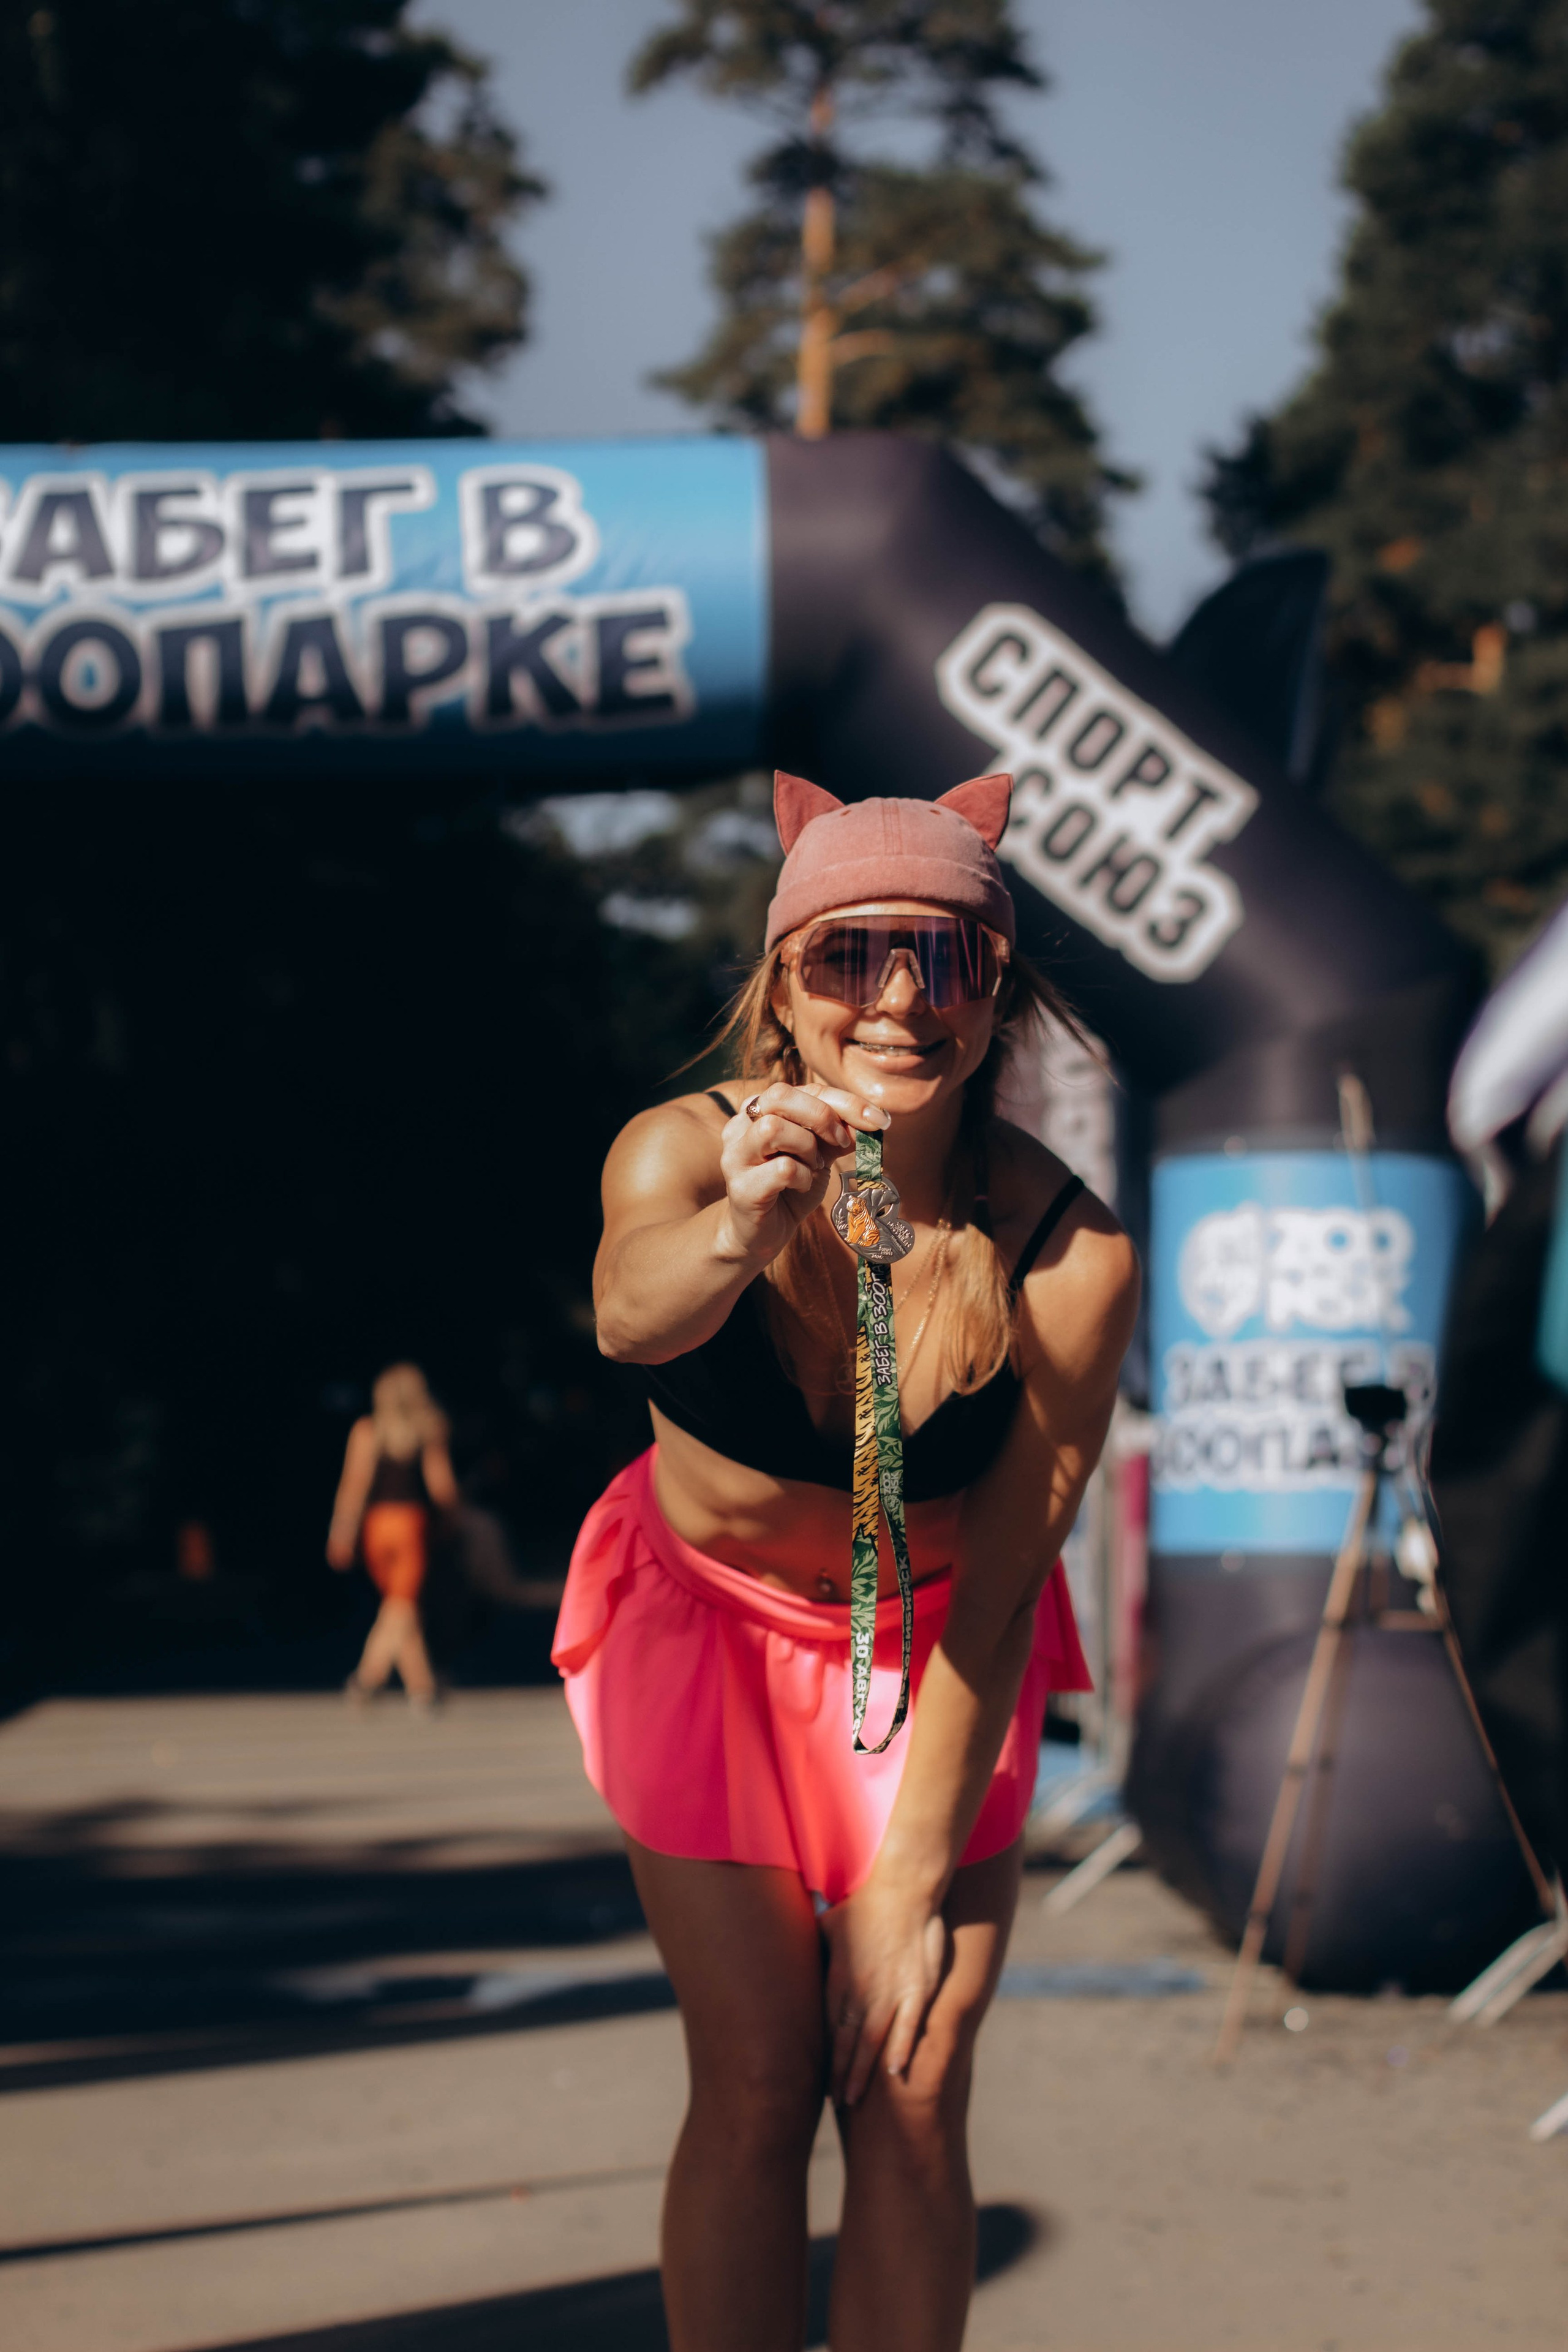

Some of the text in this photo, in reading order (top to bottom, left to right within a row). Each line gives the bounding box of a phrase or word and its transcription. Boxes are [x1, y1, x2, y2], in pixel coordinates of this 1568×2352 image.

[0, 469, 594, 593] АБЕГ В
[0, 597, 689, 729] ОПАРКЕ
[968, 631, 1223, 843] СПОРТ
[873, 1321, 888, 1335] В
[874, 1339, 892, 1386] ЗАБЕГ
[856, 1632, 870, 1659] 30
